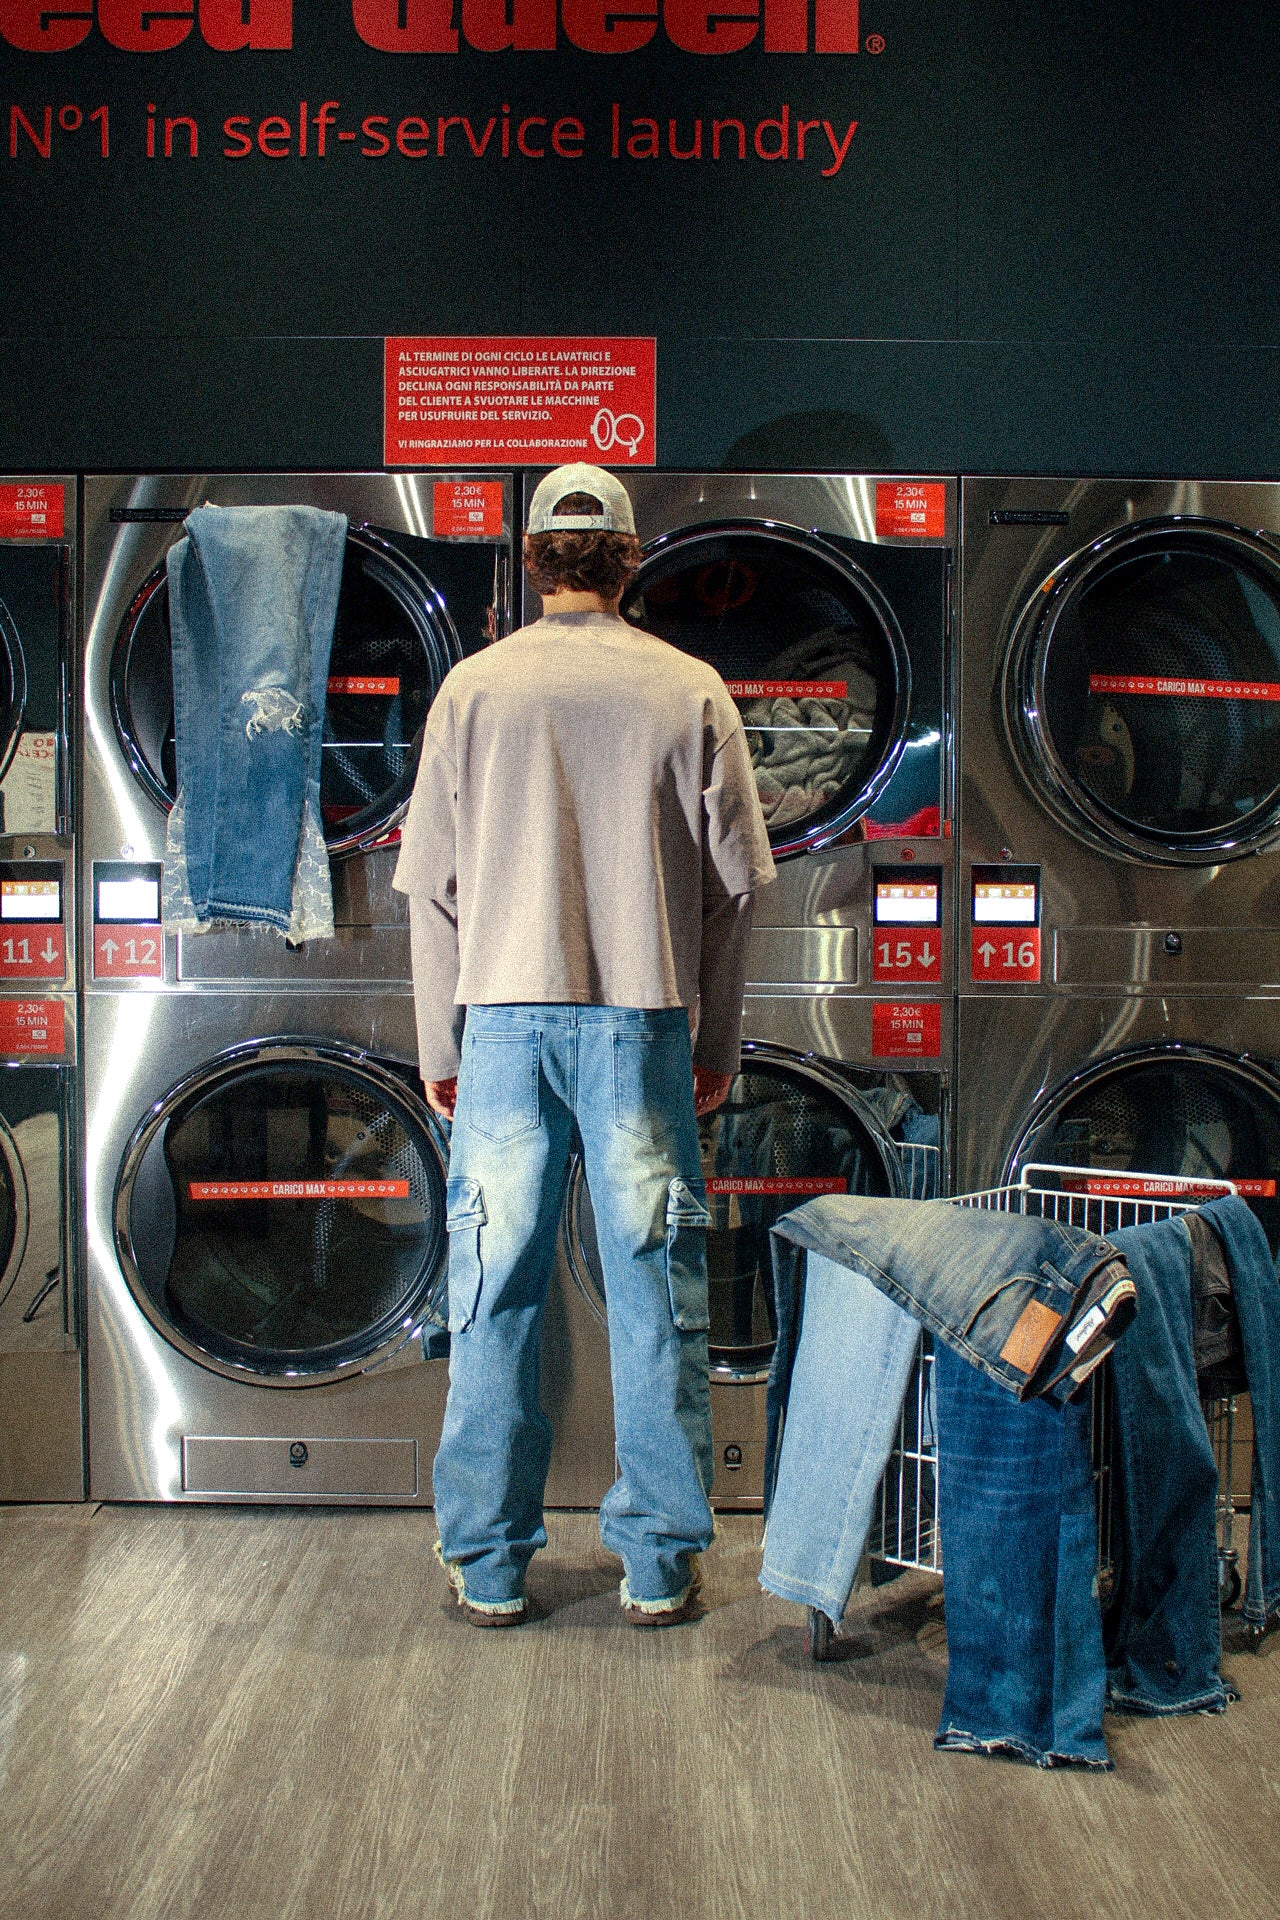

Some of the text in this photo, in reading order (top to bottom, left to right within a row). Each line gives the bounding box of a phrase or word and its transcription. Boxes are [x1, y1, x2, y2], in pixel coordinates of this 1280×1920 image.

[146, 104, 199, 158] in
[223, 101, 585, 159] self-service
[611, 103, 858, 177] laundry
[398, 352, 611, 362] AL TERMINE DI OGNI CICLO LE LAVATRICI E
[398, 366, 636, 376] ASCIUGATRICI VANNO LIBERATE. LA DIREZIONE
[398, 379, 614, 391] DECLINA OGNI RESPONSABILITÀ DA PARTE
[398, 396, 600, 406] DEL CLIENTE A SVUOTARE LE MACCHINE
[398, 411, 553, 420] PER USUFRUIRE DEL SERVIZIO.
[398, 439, 588, 448] VI RINGRAZIAMO PER LA COLLABORAZIONE
[454, 486, 482, 496] 2,30€
[15, 500, 48, 510] 15 MIN
[452, 498, 485, 508] 15 MIN
[894, 500, 927, 509] 15 MIN
[745, 684, 764, 694] MAX
[1157, 681, 1205, 693] CARICO MAX
[2, 938, 33, 964] 11
[125, 938, 157, 965] 12
[877, 942, 912, 968] 15
[1002, 942, 1035, 968] 16
[18, 1004, 45, 1014] 2,30€
[893, 1007, 921, 1017] 2,30€
[16, 1016, 48, 1026] 15 MIN
[890, 1020, 923, 1029] 15 MIN
[272, 1184, 326, 1195] CARICO MAX
[712, 1180, 764, 1191] CARICO MAX
[1143, 1182, 1194, 1192] CARICO MAX
